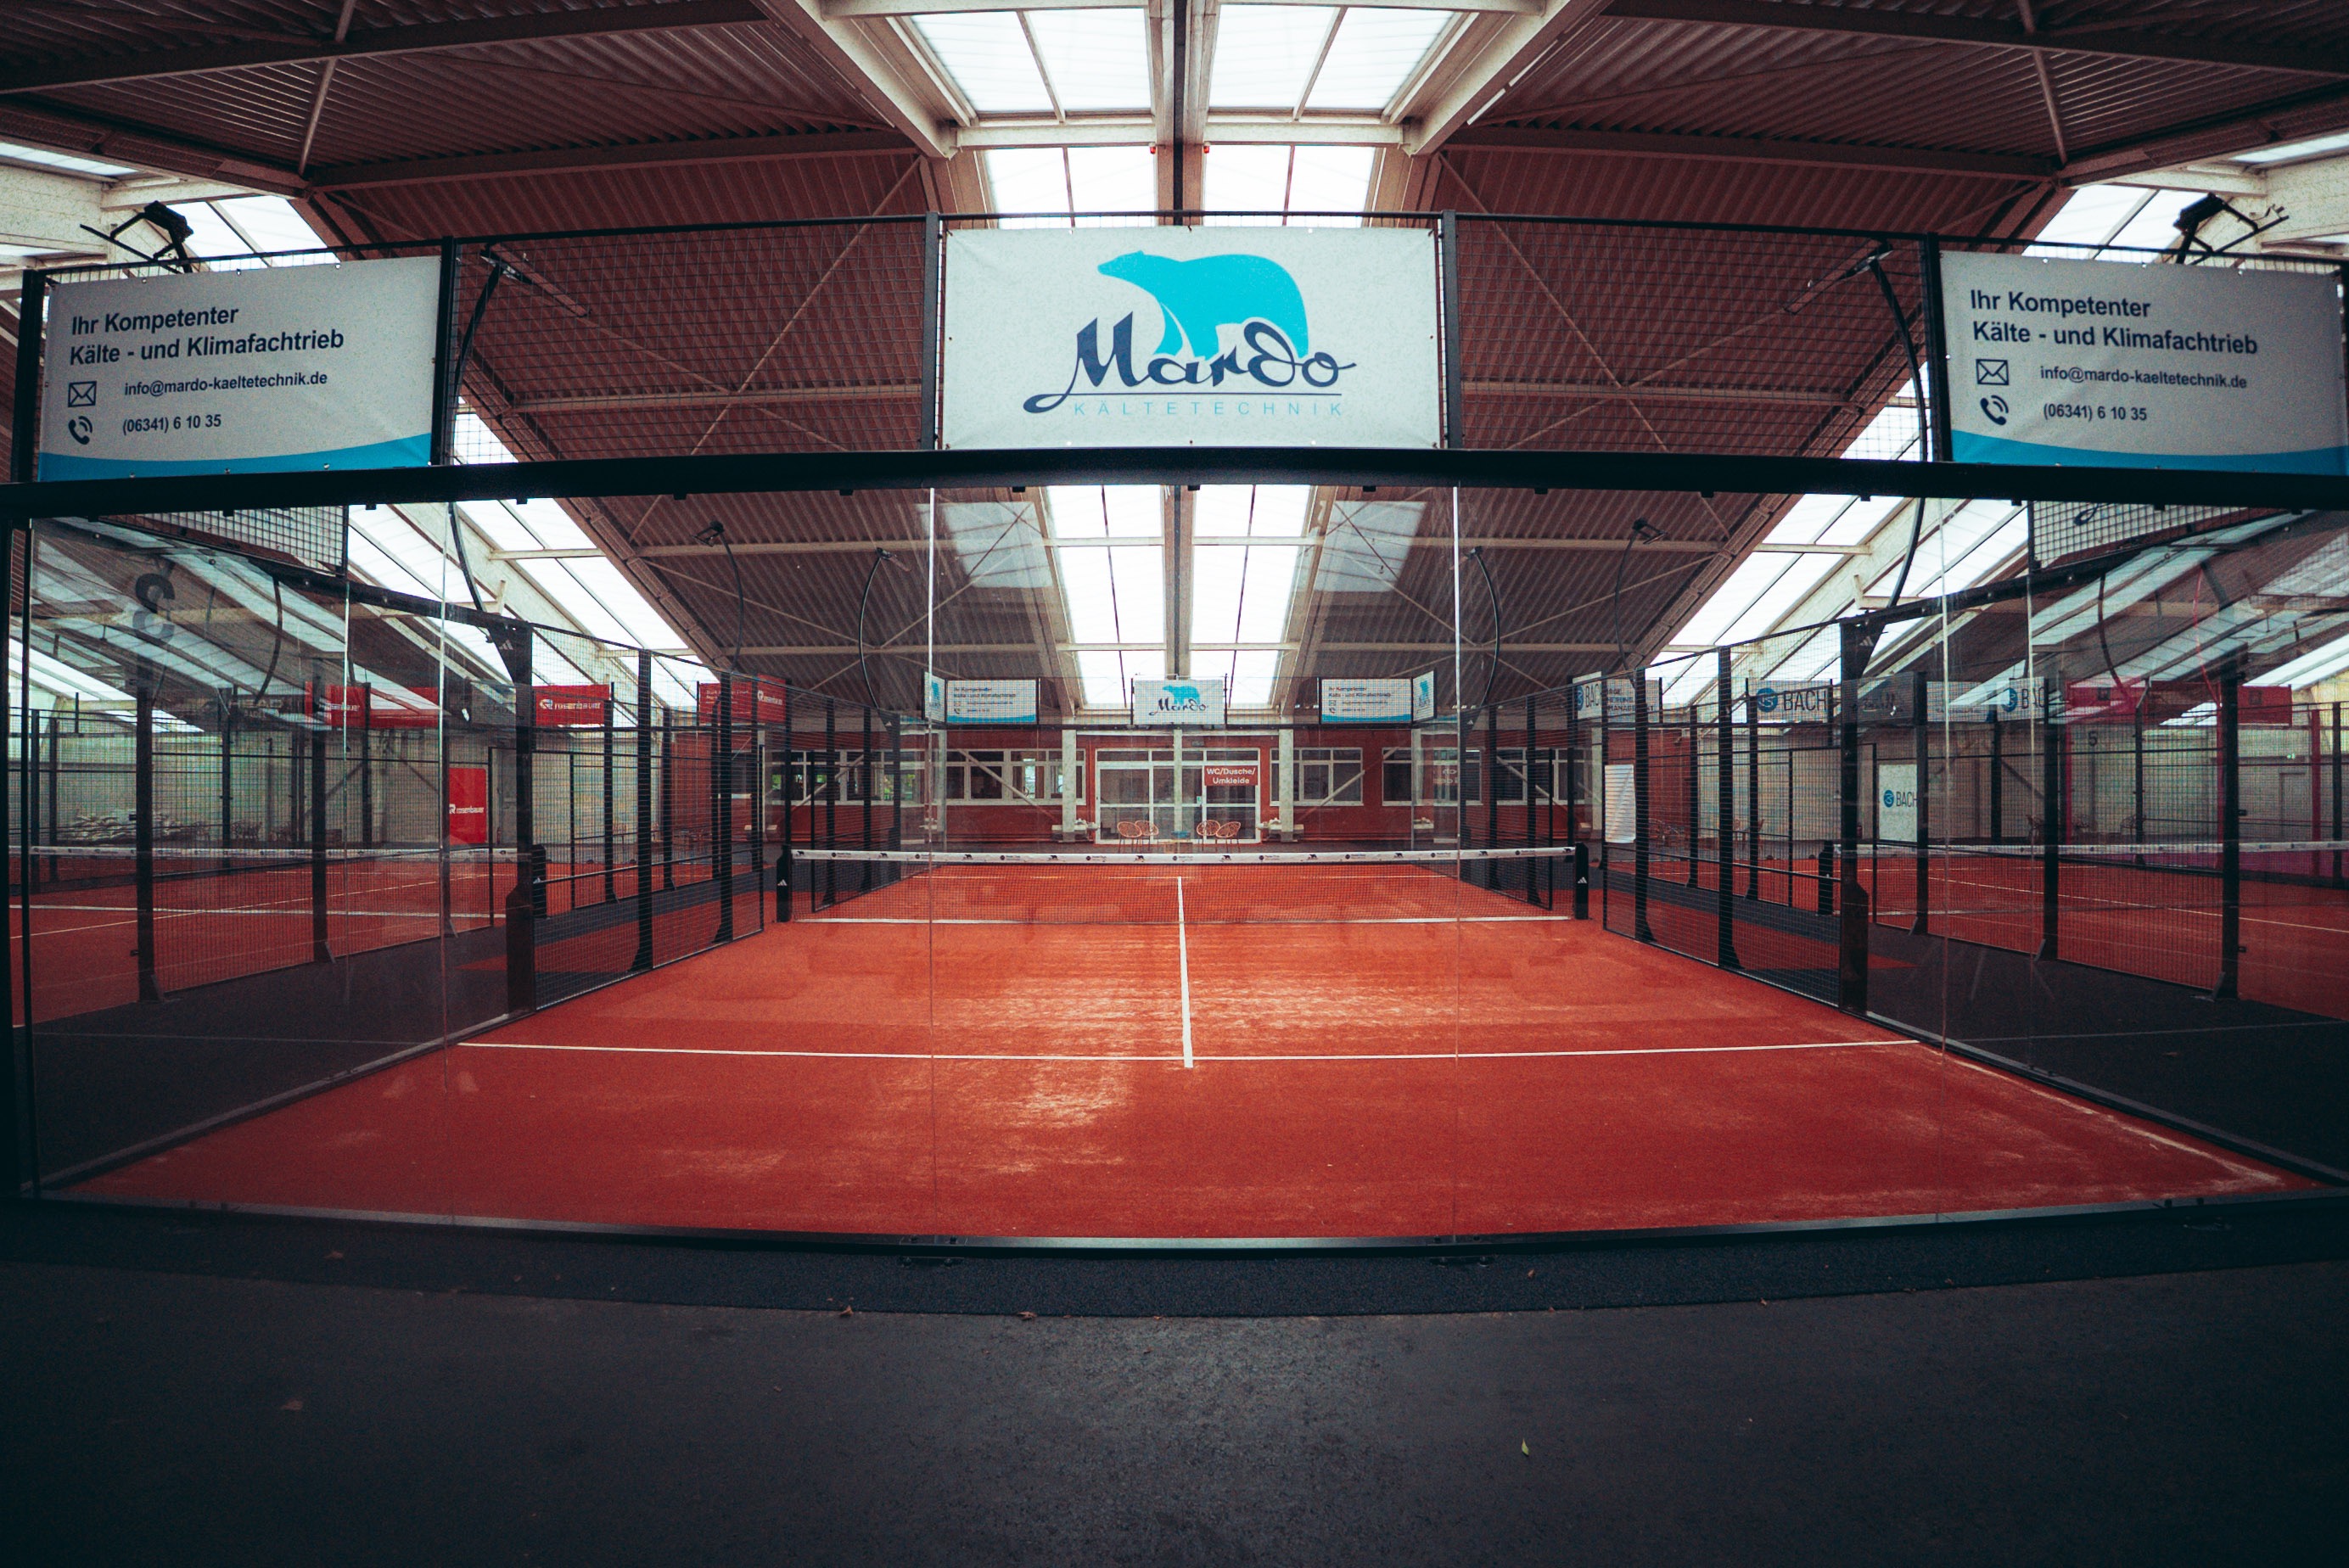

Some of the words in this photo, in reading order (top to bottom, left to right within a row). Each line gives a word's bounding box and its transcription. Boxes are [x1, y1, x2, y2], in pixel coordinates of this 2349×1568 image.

[1970, 290, 2000, 310] Ihr
[2008, 291, 2151, 318] Kompetenter
[72, 316, 99, 336] Ihr
[105, 306, 238, 334] Kompetenter
[70, 340, 120, 366] Kälte
[141, 338, 179, 361] und
[187, 328, 344, 357] Klimafachtrieb
[1973, 320, 2031, 344] Kälte
[2054, 326, 2095, 346] und
[2103, 327, 2259, 355] Klimafachtrieb
[1023, 311, 1356, 415] Mardo
[124, 371, 328, 397] info@mardo-kaeltetechnik.de
[2040, 365, 2250, 389] info@mardo-kaeltetechnik.de
[1074, 400, 1343, 417] KÄLTETECHNIK
[2043, 403, 2094, 422] (06341)
[2097, 406, 2106, 420] 6
[2111, 406, 2127, 421] 10
[2130, 406, 2148, 422] 35
[122, 417, 169, 435] (06341)
[173, 416, 182, 430] 6
[186, 415, 201, 429] 10
[205, 413, 221, 428] 35
[1148, 697, 1208, 716] Mardo
[1585, 683, 1602, 708] BAC
[1783, 689, 1828, 711] BACH
[1206, 767, 1256, 776] WC/Dusche/
